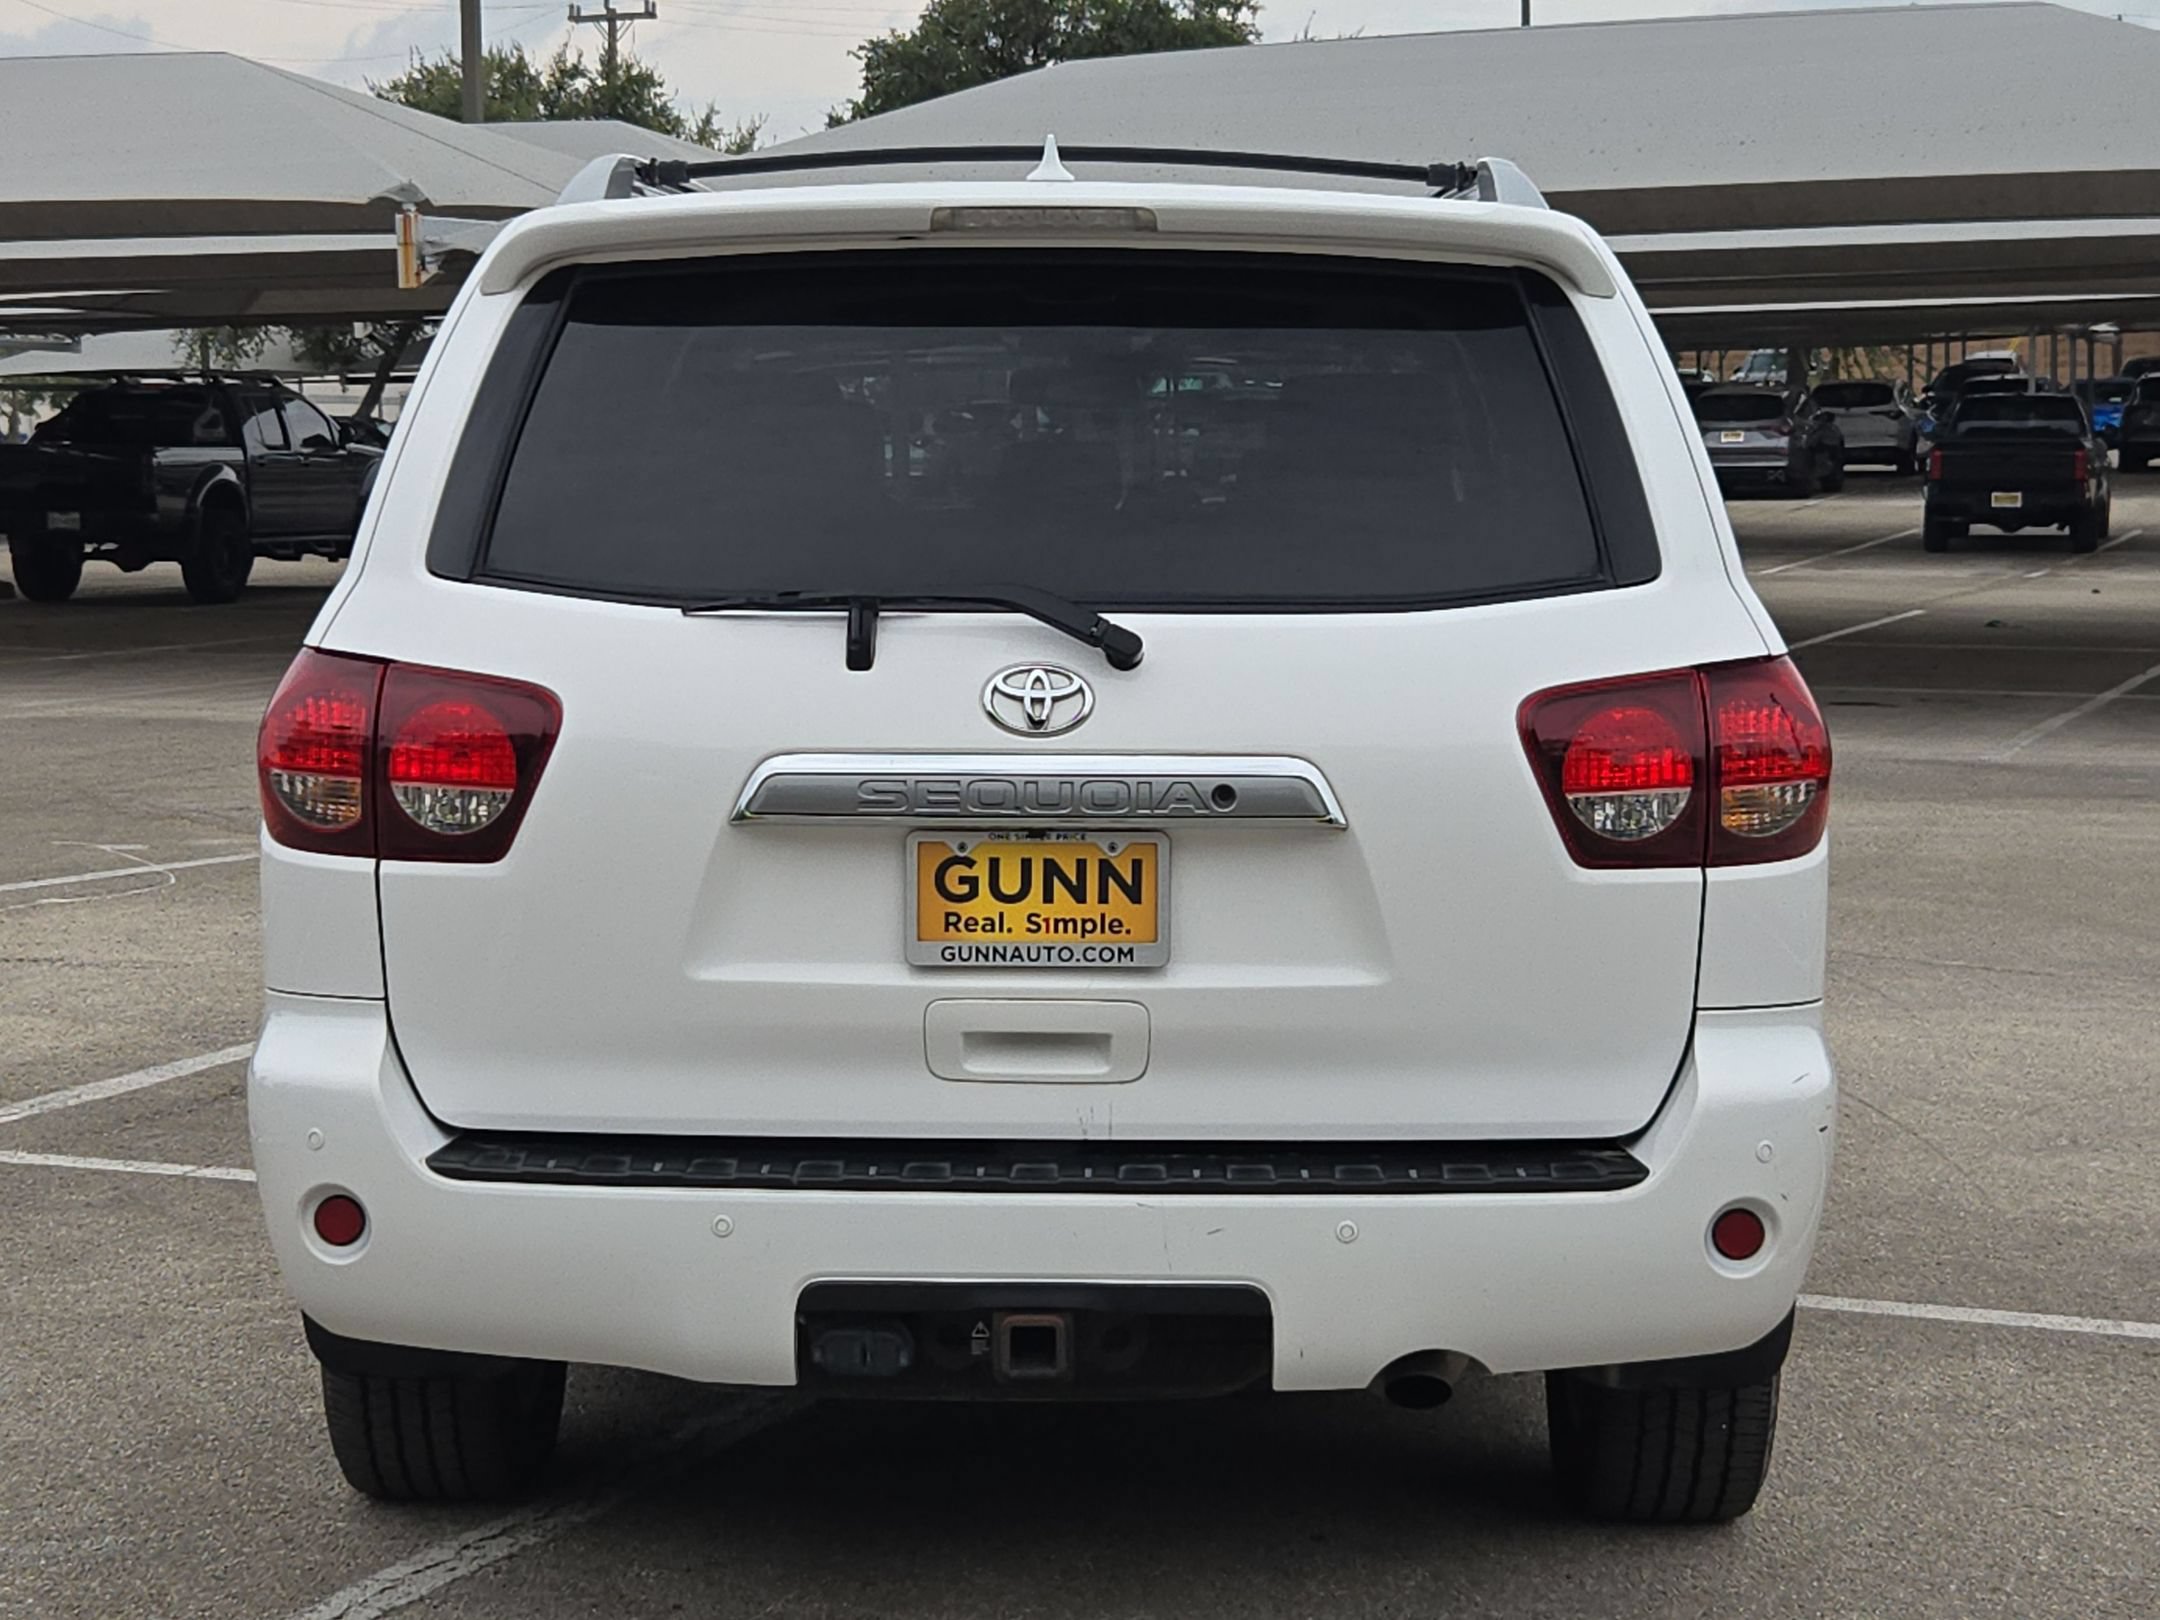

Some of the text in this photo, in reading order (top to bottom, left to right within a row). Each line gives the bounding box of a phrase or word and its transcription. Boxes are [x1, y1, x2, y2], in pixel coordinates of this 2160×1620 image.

[857, 779, 1211, 813] SEQUOIA
[1056, 832, 1087, 841] PRICE
[934, 855, 1143, 905] GUNN
[944, 911, 1013, 934] Real.
[941, 946, 1135, 963] GUNNAUTO.COM
